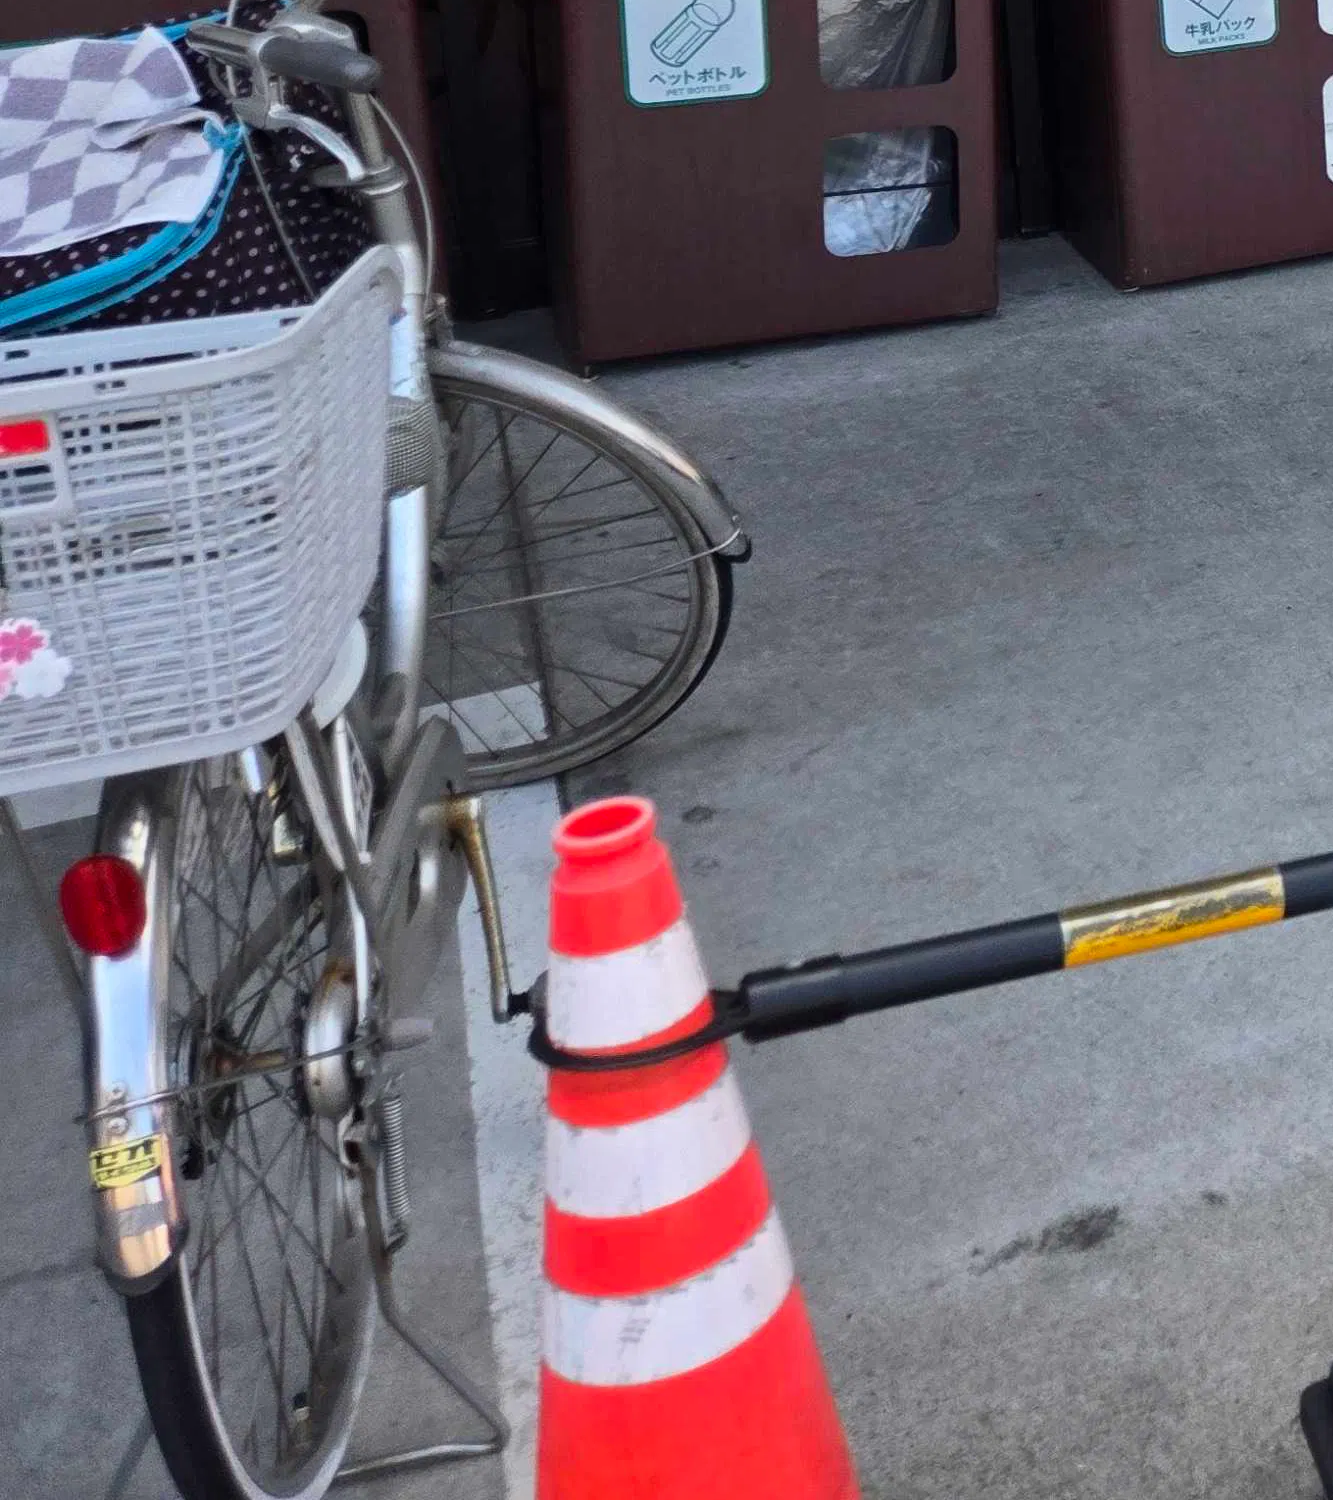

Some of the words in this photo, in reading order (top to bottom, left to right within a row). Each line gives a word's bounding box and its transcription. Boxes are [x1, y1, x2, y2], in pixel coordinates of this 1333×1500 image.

[1184, 16, 1256, 39] 牛乳パック
[1197, 35, 1217, 45] MILK
[1219, 32, 1246, 43] PACKS
[648, 65, 748, 87] ペットボトル
[665, 86, 686, 97] PET
[686, 83, 732, 95] BOTTLES
